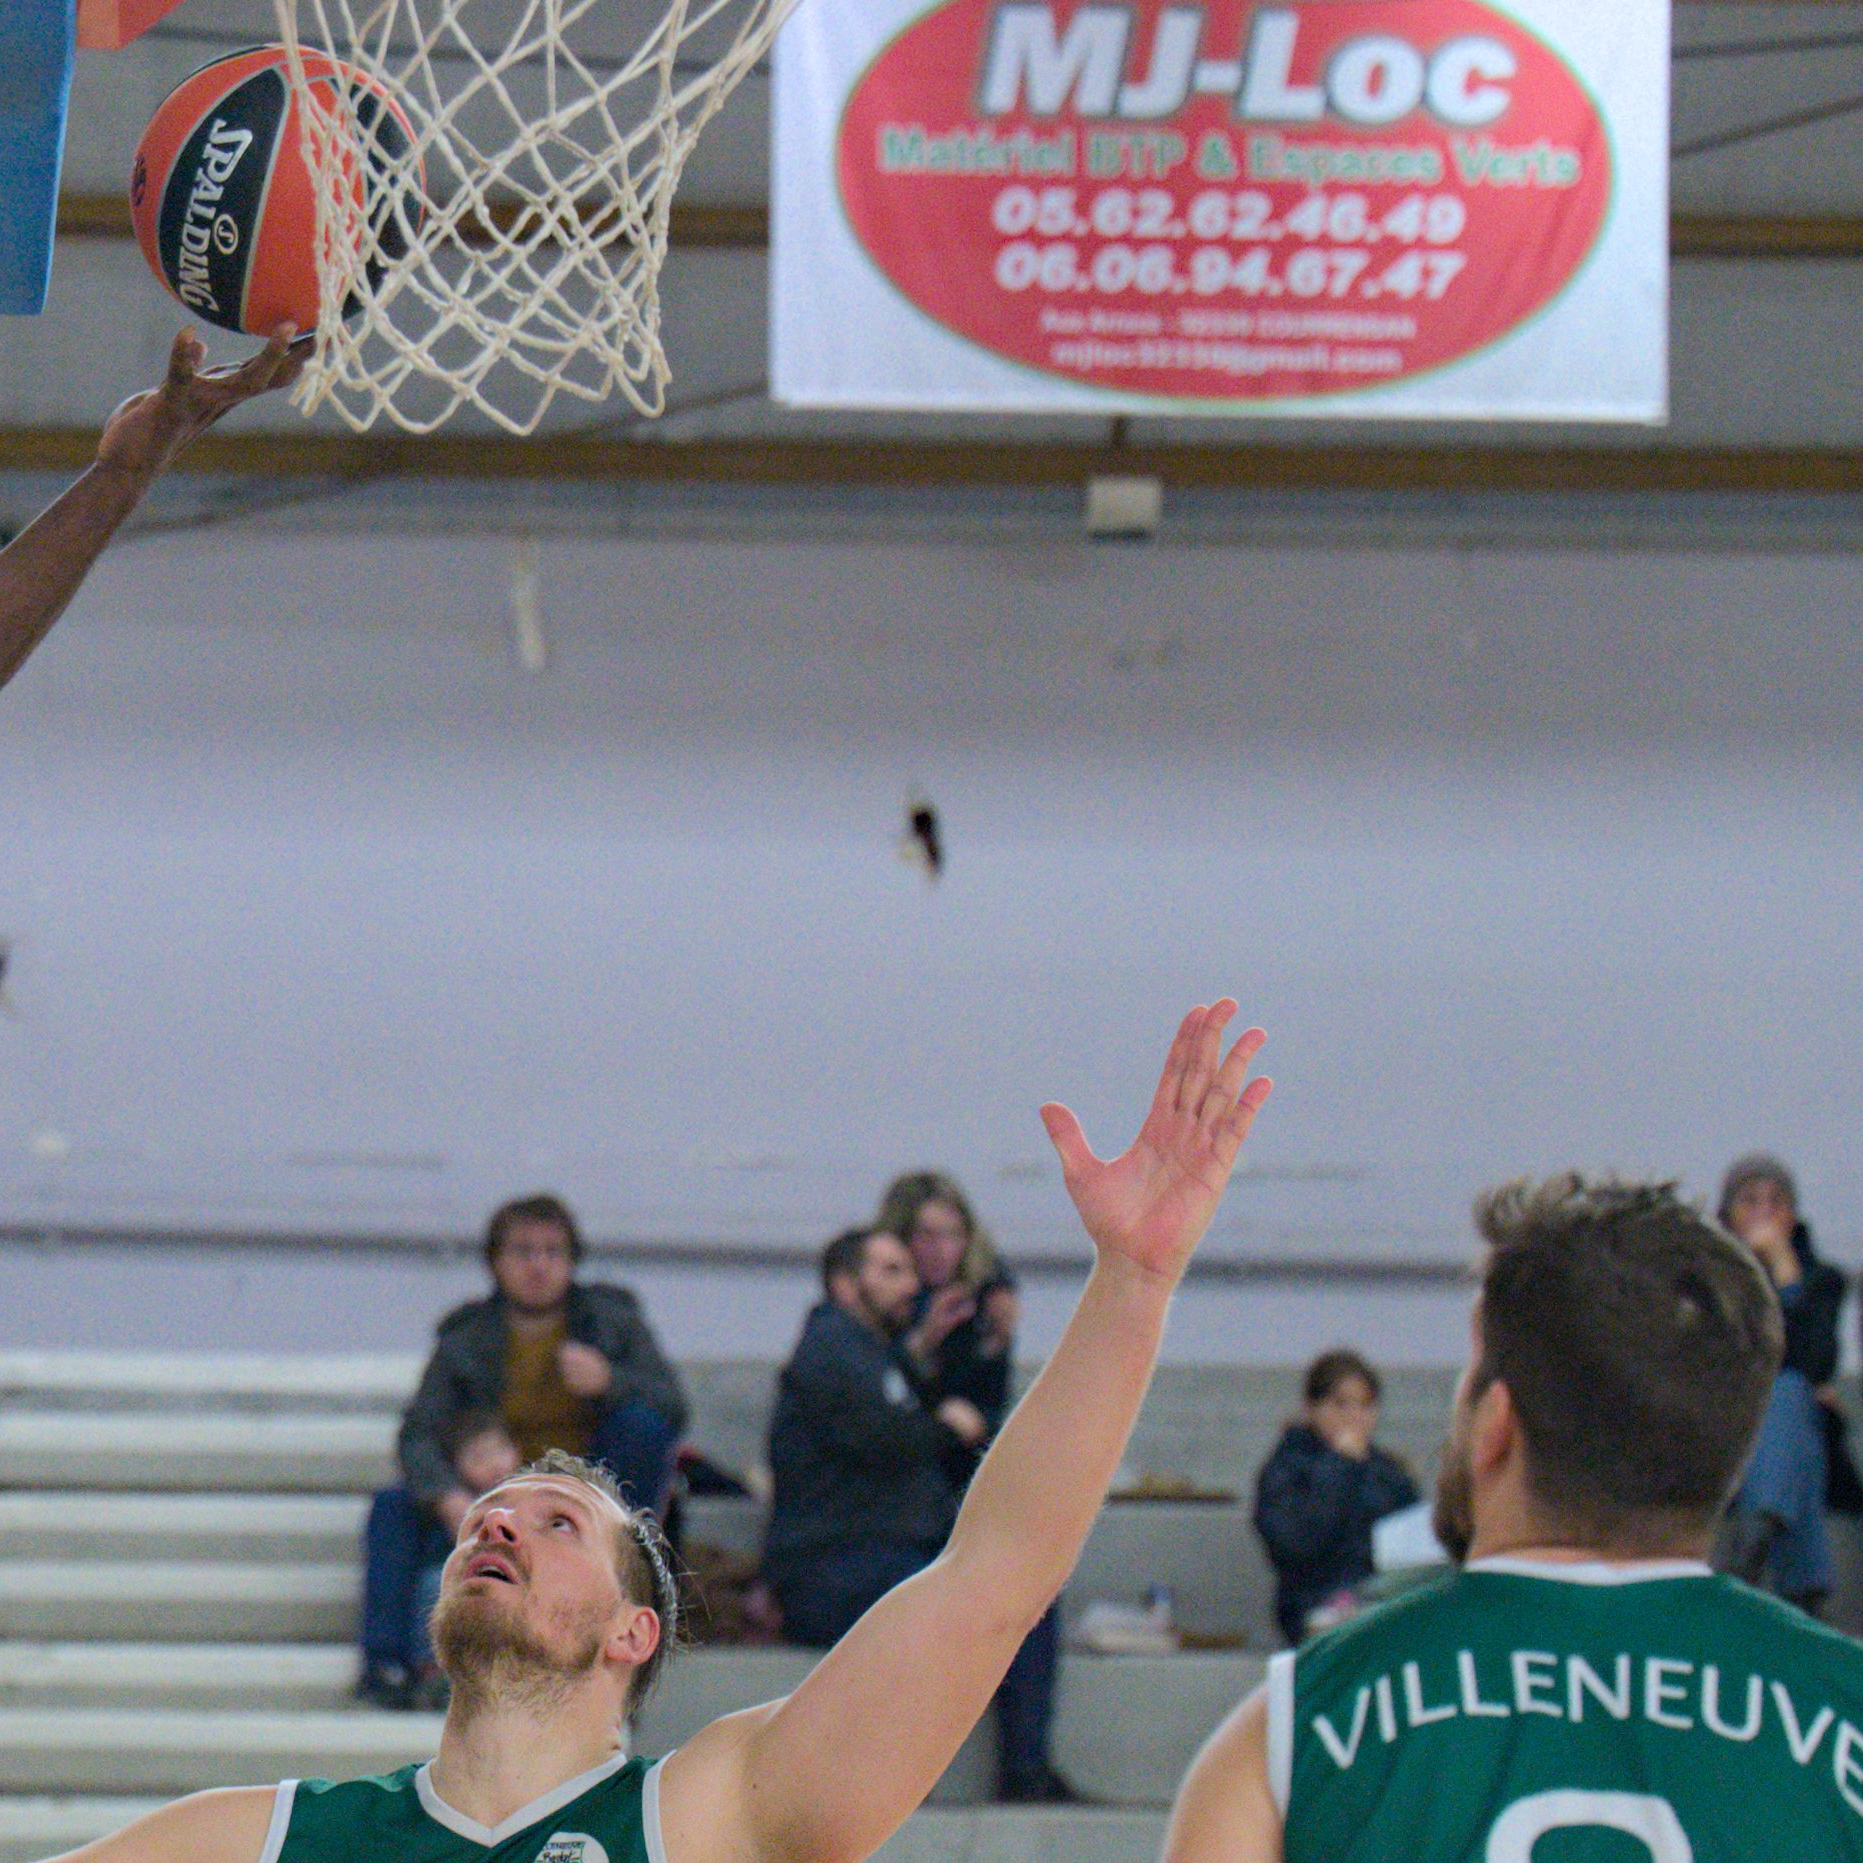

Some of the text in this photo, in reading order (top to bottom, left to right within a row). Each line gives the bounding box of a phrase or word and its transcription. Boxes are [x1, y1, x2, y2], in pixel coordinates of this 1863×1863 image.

[179, 118, 252, 312] SPALDING
[1087, 126, 1184, 180] BTP
[1197, 128, 1239, 182] &
[1250, 132, 1443, 190] Espaces
[1447, 140, 1582, 189] Verts
